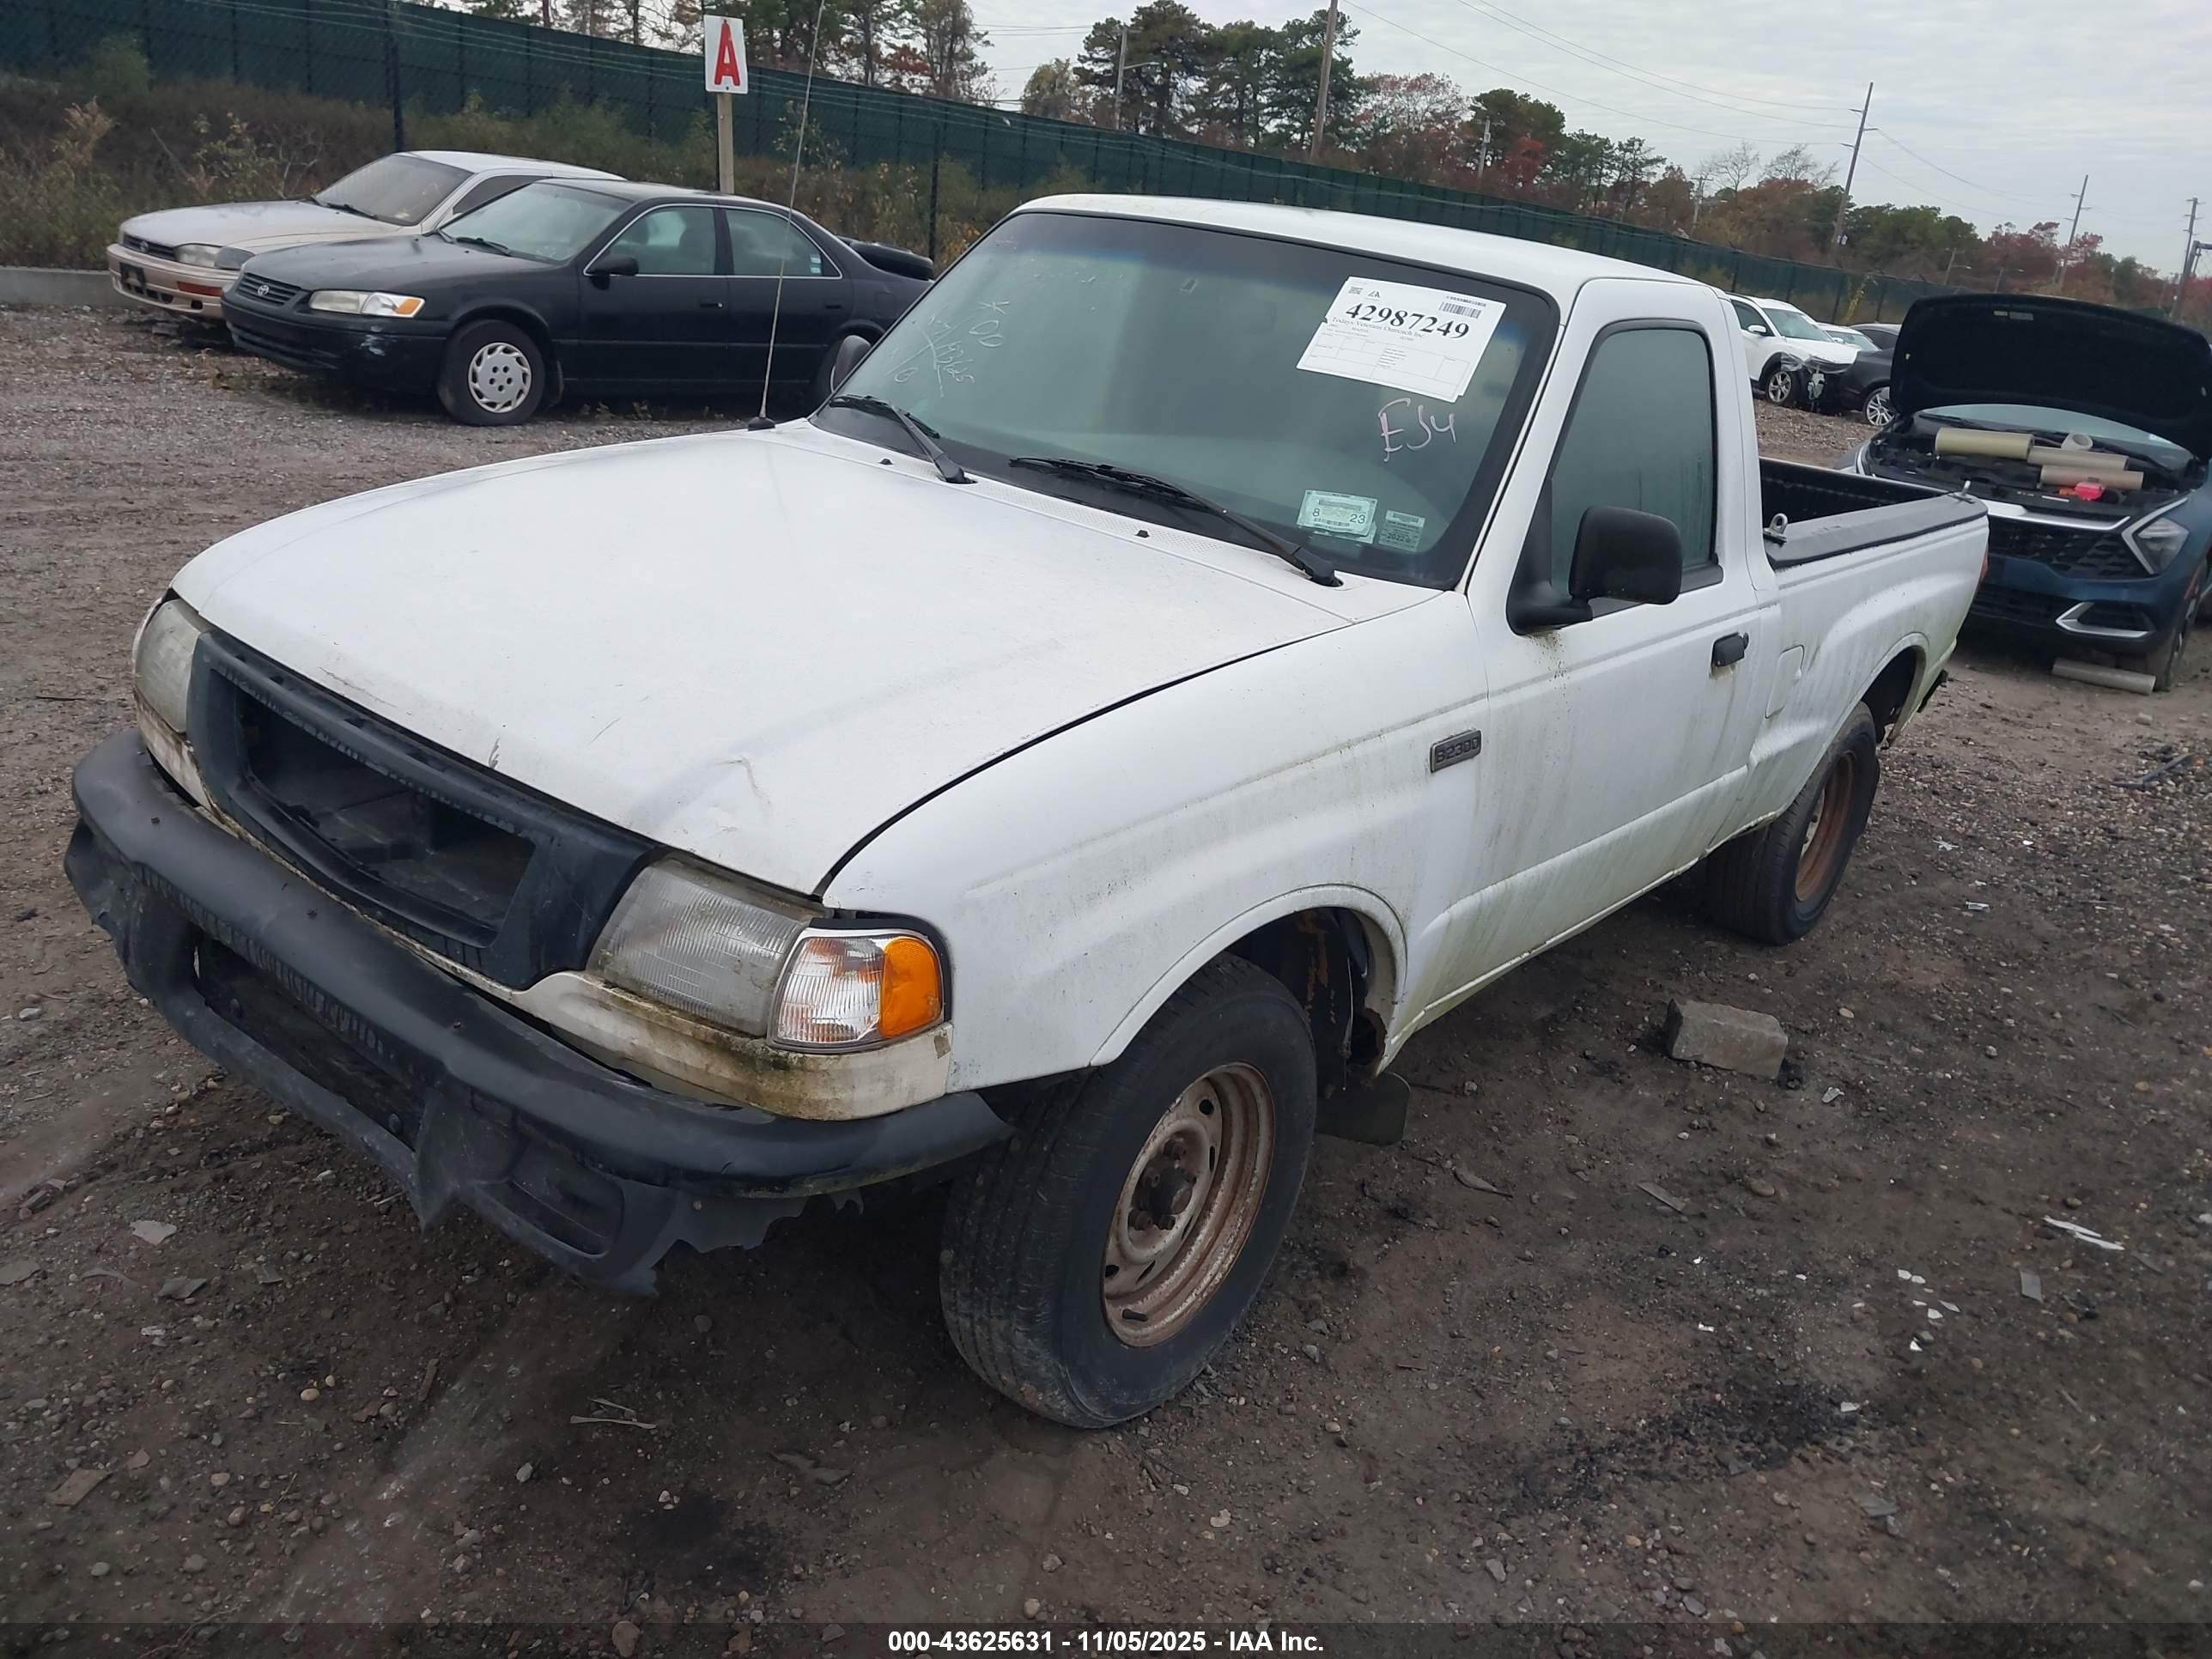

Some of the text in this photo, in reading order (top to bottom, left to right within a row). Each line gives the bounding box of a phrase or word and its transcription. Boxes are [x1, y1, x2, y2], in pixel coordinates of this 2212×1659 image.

[714, 22, 741, 87] A
[1346, 302, 1470, 339] 42987249
[1312, 507, 1321, 517] 8
[1349, 514, 1366, 524] 23
[1437, 737, 1479, 763] B2300
